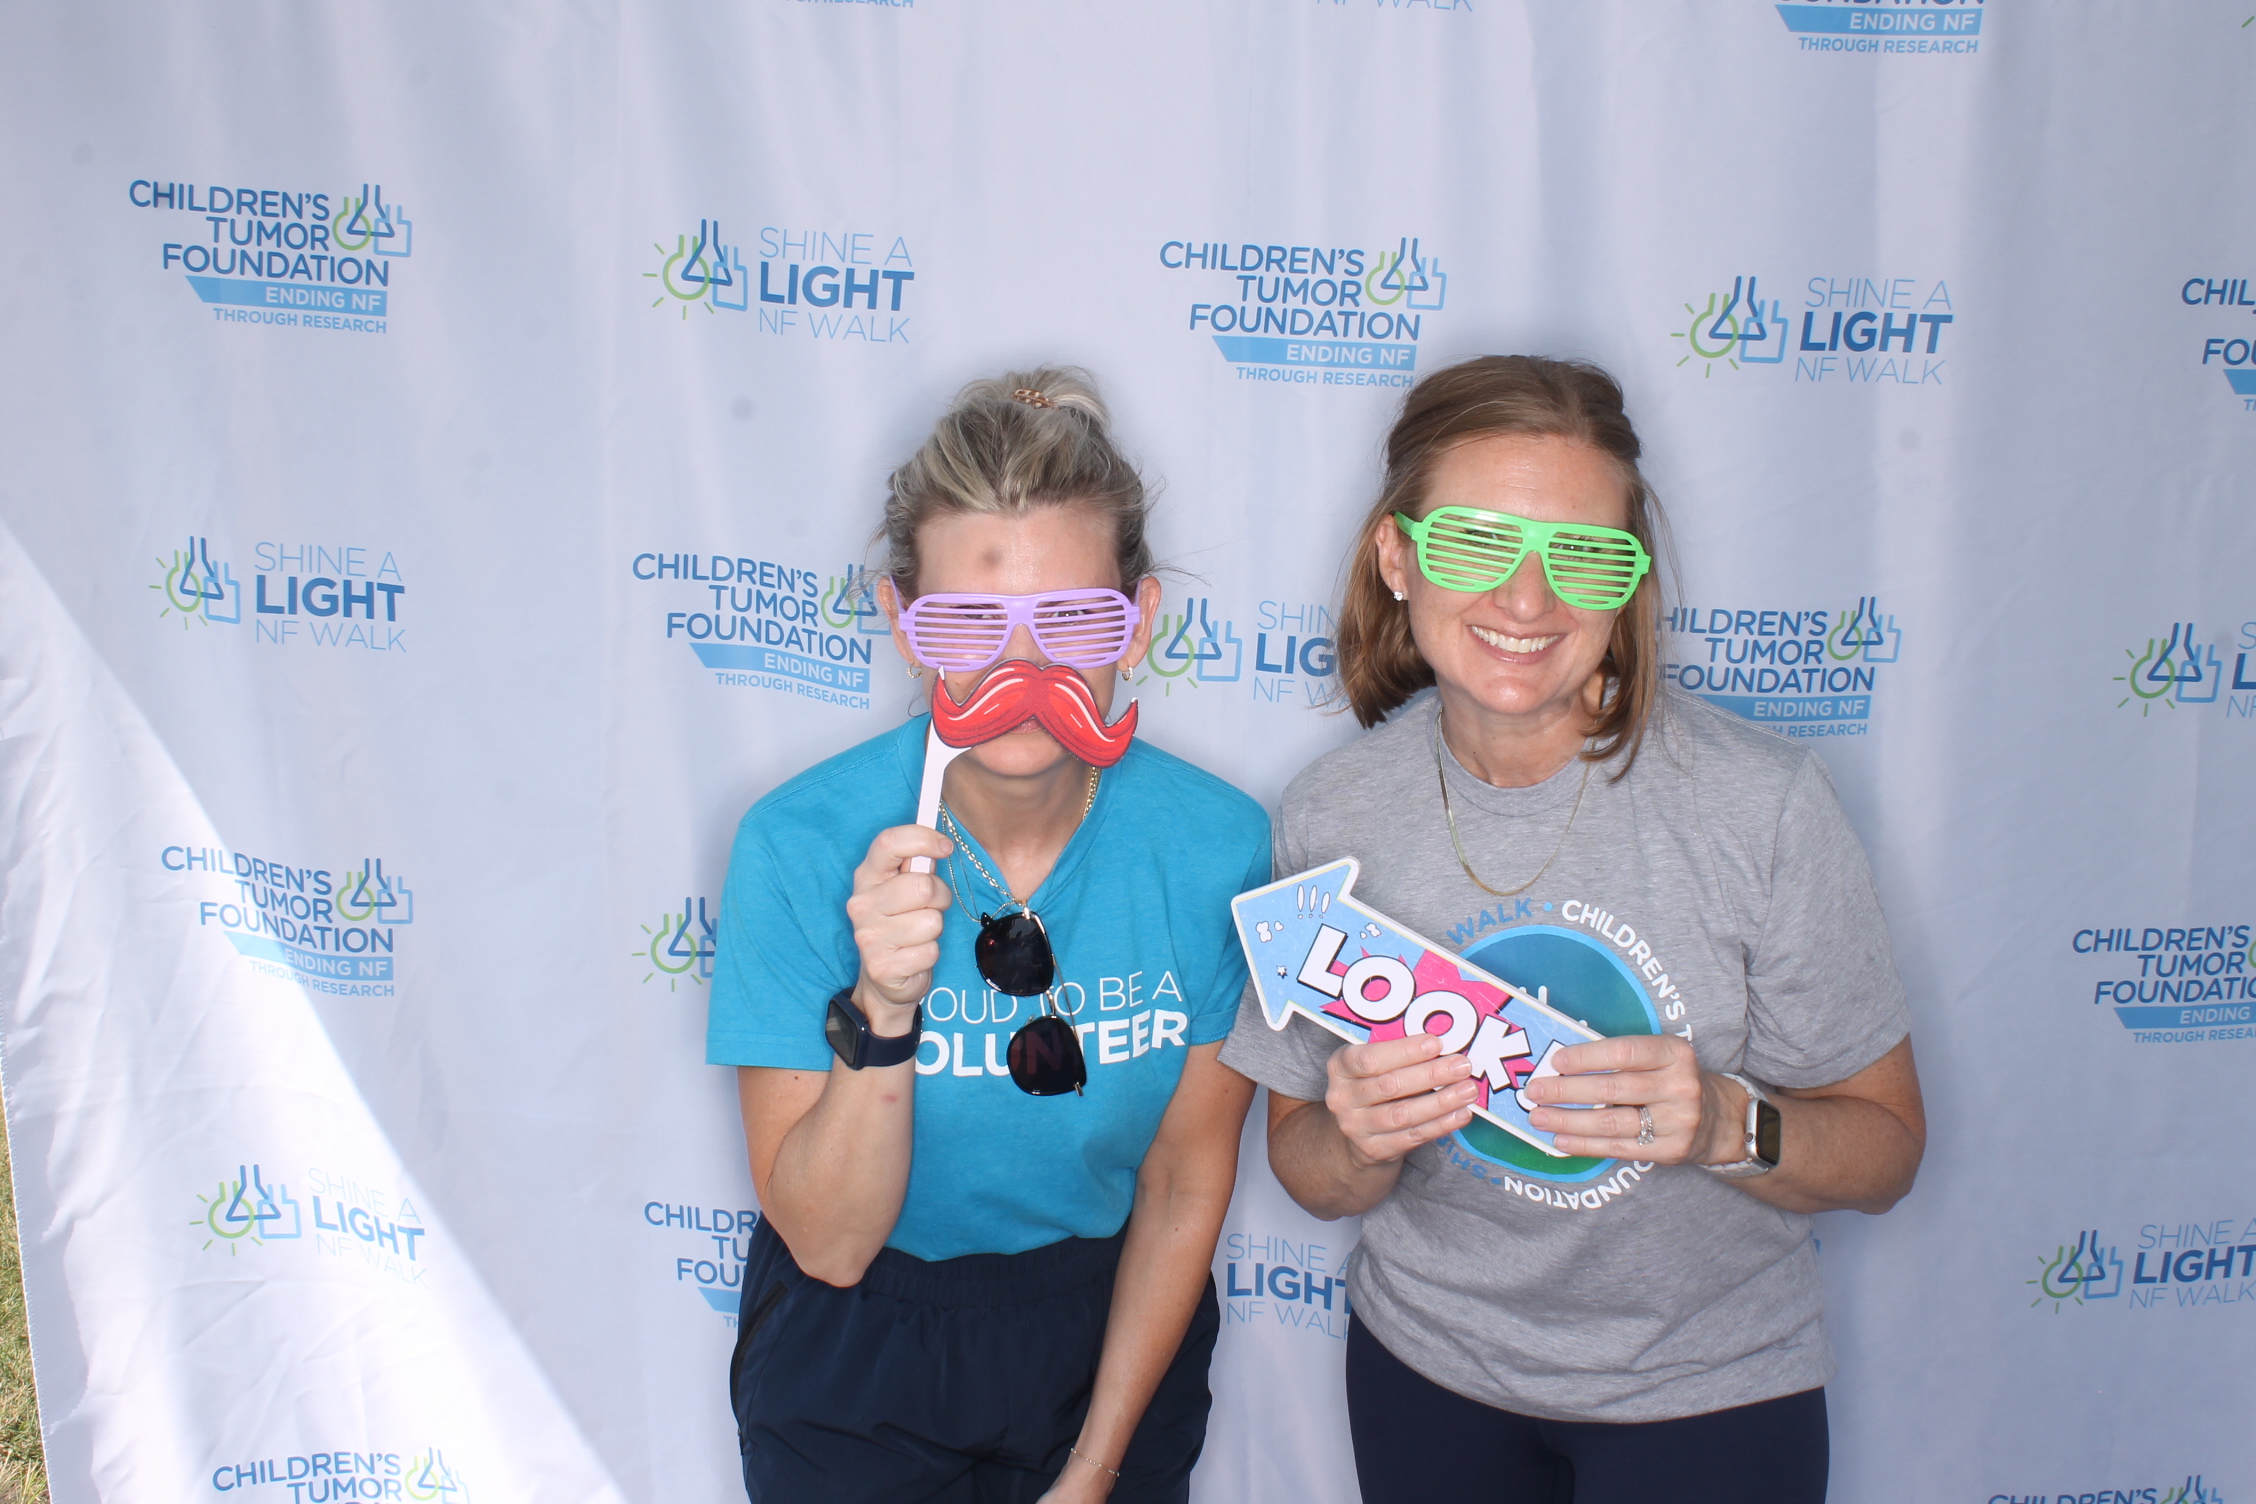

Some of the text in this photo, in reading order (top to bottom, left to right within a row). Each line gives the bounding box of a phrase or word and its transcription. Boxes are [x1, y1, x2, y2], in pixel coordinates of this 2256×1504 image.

[1850, 12, 1976, 31] ENDING NF
[1798, 37, 1979, 54] THROUGH RESEARCH
[129, 179, 330, 222] CHILDREN'S
[205, 216, 330, 252] TUMOR
[759, 226, 912, 267] SHINE A
[163, 243, 389, 287] FOUNDATION
[1160, 241, 1365, 276] CHILDREN'S
[265, 286, 382, 311] ENDING NF
[760, 261, 915, 311] LIGHT
[1236, 275, 1362, 307] TUMOR
[1805, 277, 1952, 310] SHINE A
[213, 307, 387, 334] THROUGH RESEARCH
[759, 307, 911, 344] NF WALK
[1189, 304, 1421, 340] FOUNDATION
[1800, 311, 1954, 354] LIGHT
[1286, 344, 1411, 366] ENDING NF
[1795, 357, 1946, 385] NF WALK
[1236, 366, 1415, 388] THROUGH RESEARCH
[254, 541, 402, 581] SHINE A
[632, 553, 819, 598] CHILDREN'S
[256, 574, 405, 622] LIGHT
[708, 584, 819, 627] TUMOR
[1257, 600, 1339, 634] SHIN
[1656, 607, 1829, 637] HILDREN'S
[256, 619, 407, 653] NF WALK
[667, 612, 872, 665] FOUNDATION
[1704, 637, 1826, 666] TUMOR
[764, 653, 865, 687] ENDING NF
[1255, 632, 1337, 678] LIG
[715, 672, 870, 710] THROUGH RESEARCH
[1253, 676, 1296, 703] NF
[1753, 700, 1866, 717] ENDING NF
[1787, 723, 1868, 738] RESEARCH
[161, 845, 332, 896] CHILDREN'S
[234, 879, 333, 923] TUMOR
[200, 902, 394, 953] FOUNDATION
[1446, 898, 1534, 946] WALK
[2072, 924, 2250, 953] CHILDREN'S
[284, 947, 388, 976] ENDING NF
[1561, 899, 1686, 1021] CHILDREN'S
[2137, 951, 2246, 978] TUMOR
[249, 960, 394, 997] THROUGH RESEARCH
[919, 986, 1018, 1024] OUD
[1099, 971, 1143, 1012] BE
[1152, 970, 1183, 1002] A
[2180, 1006, 2251, 1024] ENDING
[915, 1009, 1189, 1077] OLUNTEER
[2133, 1031, 2204, 1043] THROUGH
[308, 1167, 422, 1225] SHINE A
[312, 1195, 425, 1262] LIGHT
[2138, 1219, 2234, 1249] SHINE
[316, 1233, 429, 1290] NF WALK
[1226, 1233, 1327, 1273] SHINE
[2133, 1244, 2256, 1285] LIGHT
[1227, 1301, 1265, 1325] NF
[2129, 1281, 2256, 1310] NF WALK
[212, 1452, 401, 1491] CHILDREN'S
[287, 1476, 402, 1504] TUMOR
